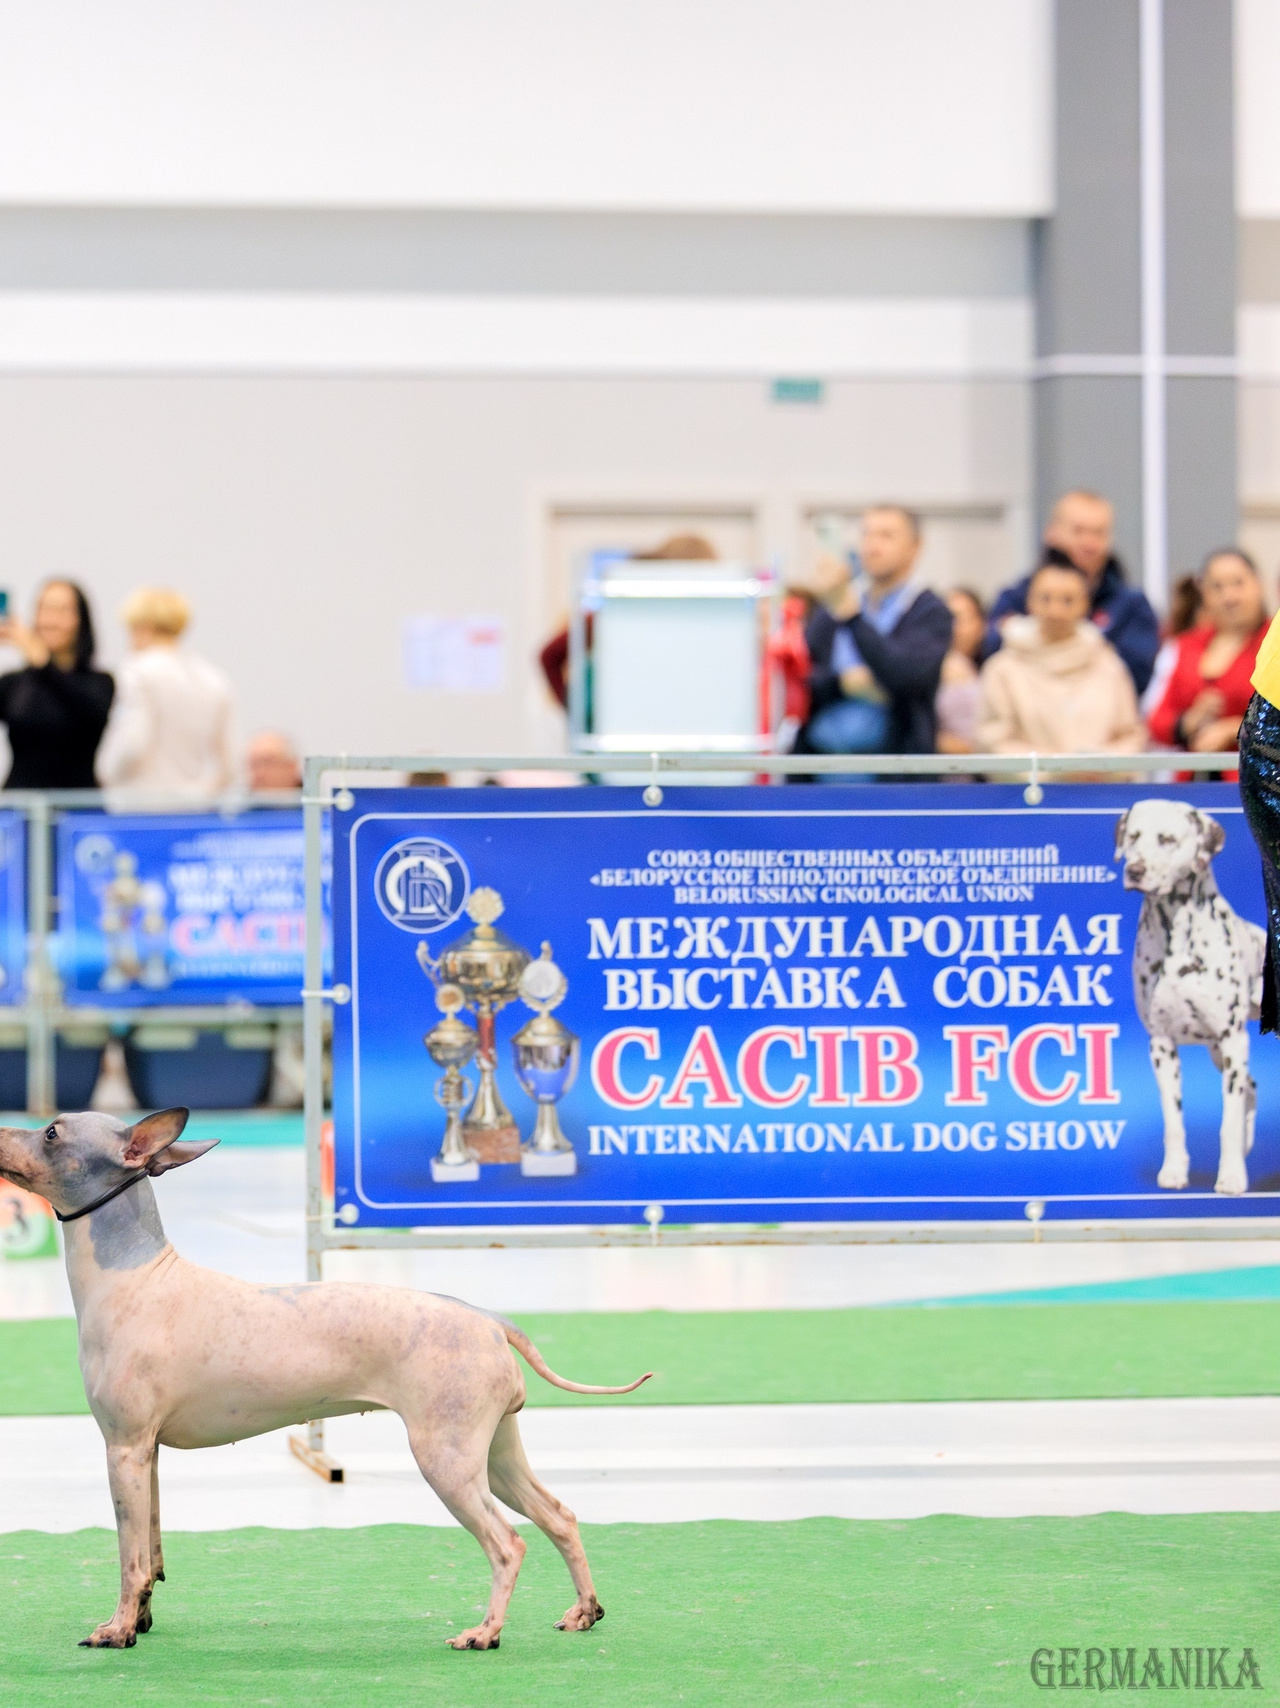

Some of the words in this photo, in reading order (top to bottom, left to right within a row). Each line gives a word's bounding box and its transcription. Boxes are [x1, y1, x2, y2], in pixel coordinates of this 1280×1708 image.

[647, 850, 712, 868] СОЮЗ
[714, 849, 894, 868] ОБЩЕСТВЕННЫХ
[897, 844, 1059, 867] ОБЪЕДИНЕНИЙ
[674, 886, 818, 904] BELORUSSIAN
[820, 885, 963, 903] CINOLOGICAL
[966, 884, 1035, 902] UNION
[758, 867, 961, 886] КИНОЛОГИЧЕСКОЕ
[586, 913, 1123, 967] МЕЖДУНАРОДНАЯ
[602, 966, 907, 1011] ВЫСТАВКА
[932, 964, 1115, 1008] СОБАК
[590, 1025, 924, 1110] CACIB
[942, 1022, 1121, 1107] FCI
[587, 1122, 905, 1155] INTERNATIONAL
[911, 1121, 999, 1152] DOG
[1004, 1119, 1127, 1150] SHOW
